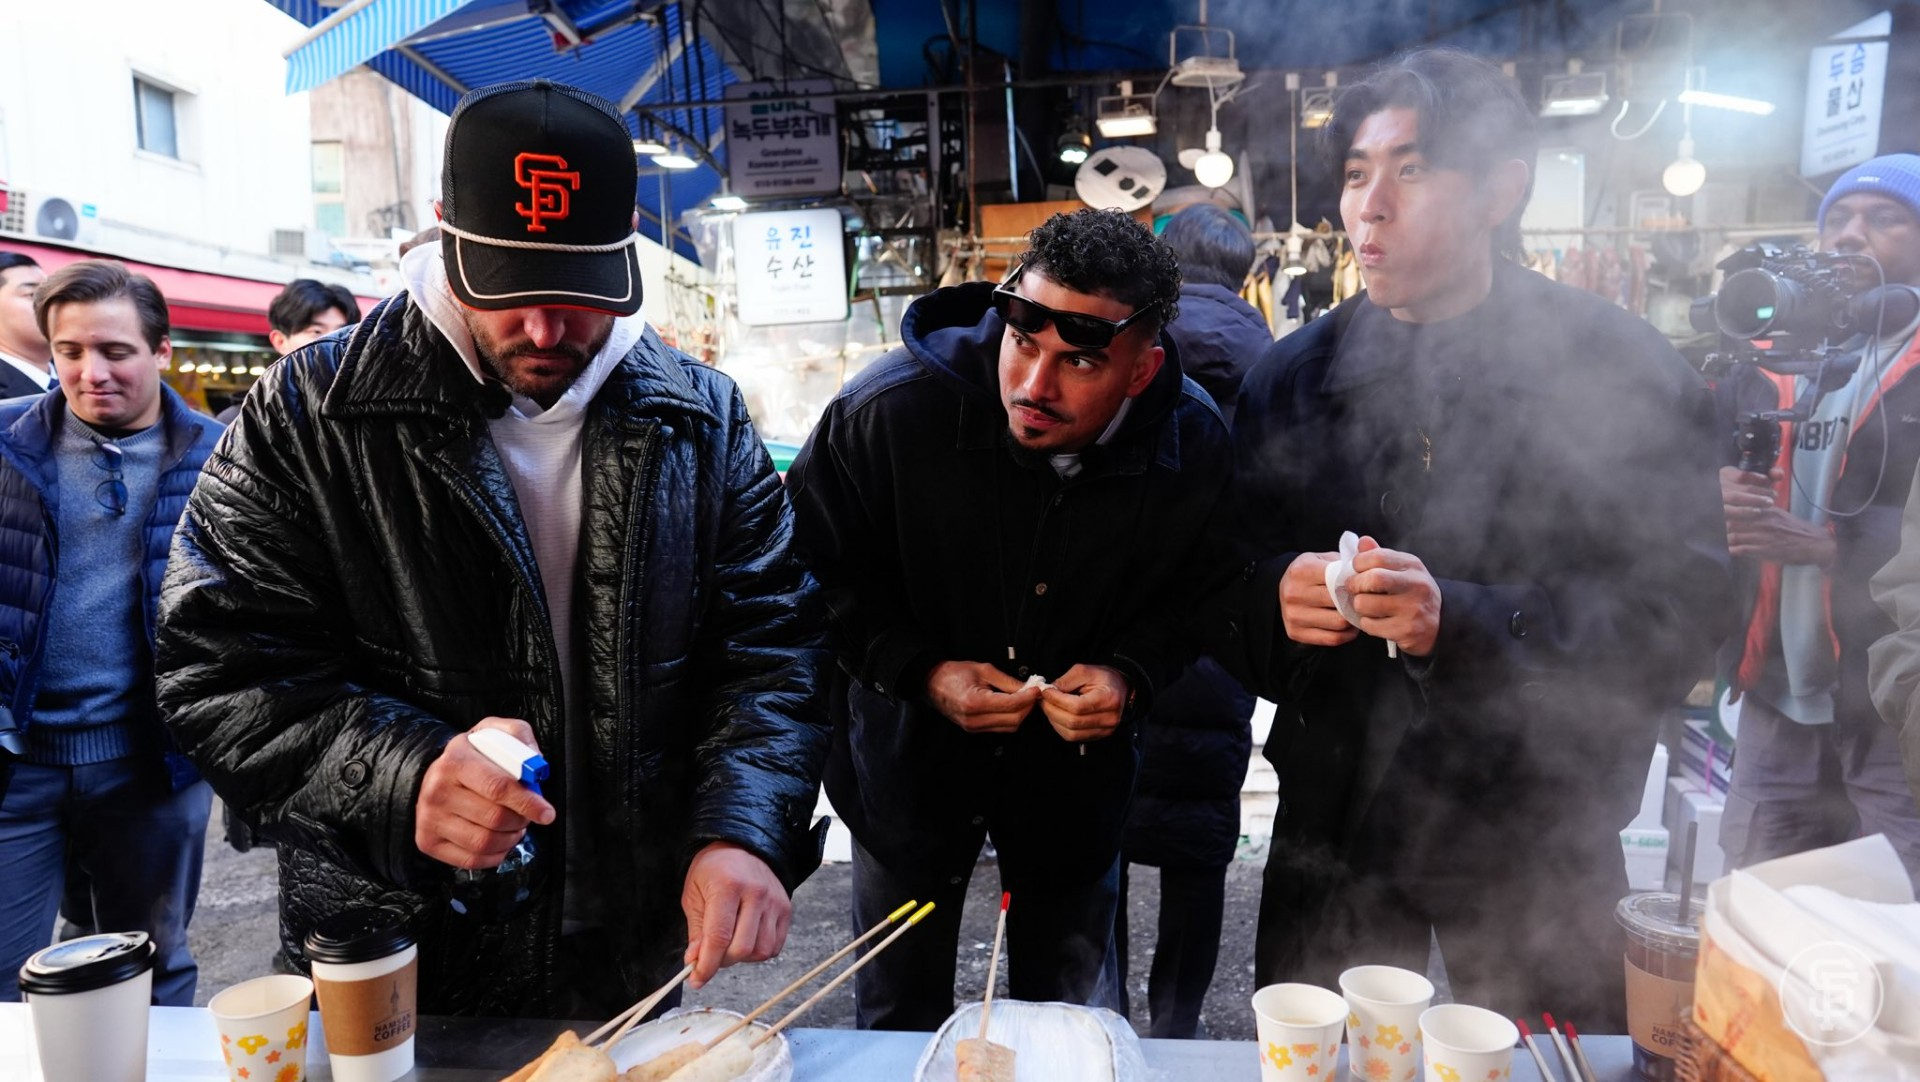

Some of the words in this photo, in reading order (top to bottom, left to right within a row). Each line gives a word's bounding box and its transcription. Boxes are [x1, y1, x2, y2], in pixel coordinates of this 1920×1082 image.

[748, 161, 779, 169] Korean
[514, 152, 581, 232] SF
[765, 225, 814, 250] 유진
[766, 254, 815, 279] 수산
[374, 1020, 411, 1041] COFFEE
[375, 1013, 411, 1032] NAMSAN
[1652, 1026, 1676, 1038] NAM
[1652, 1034, 1676, 1046] COF
